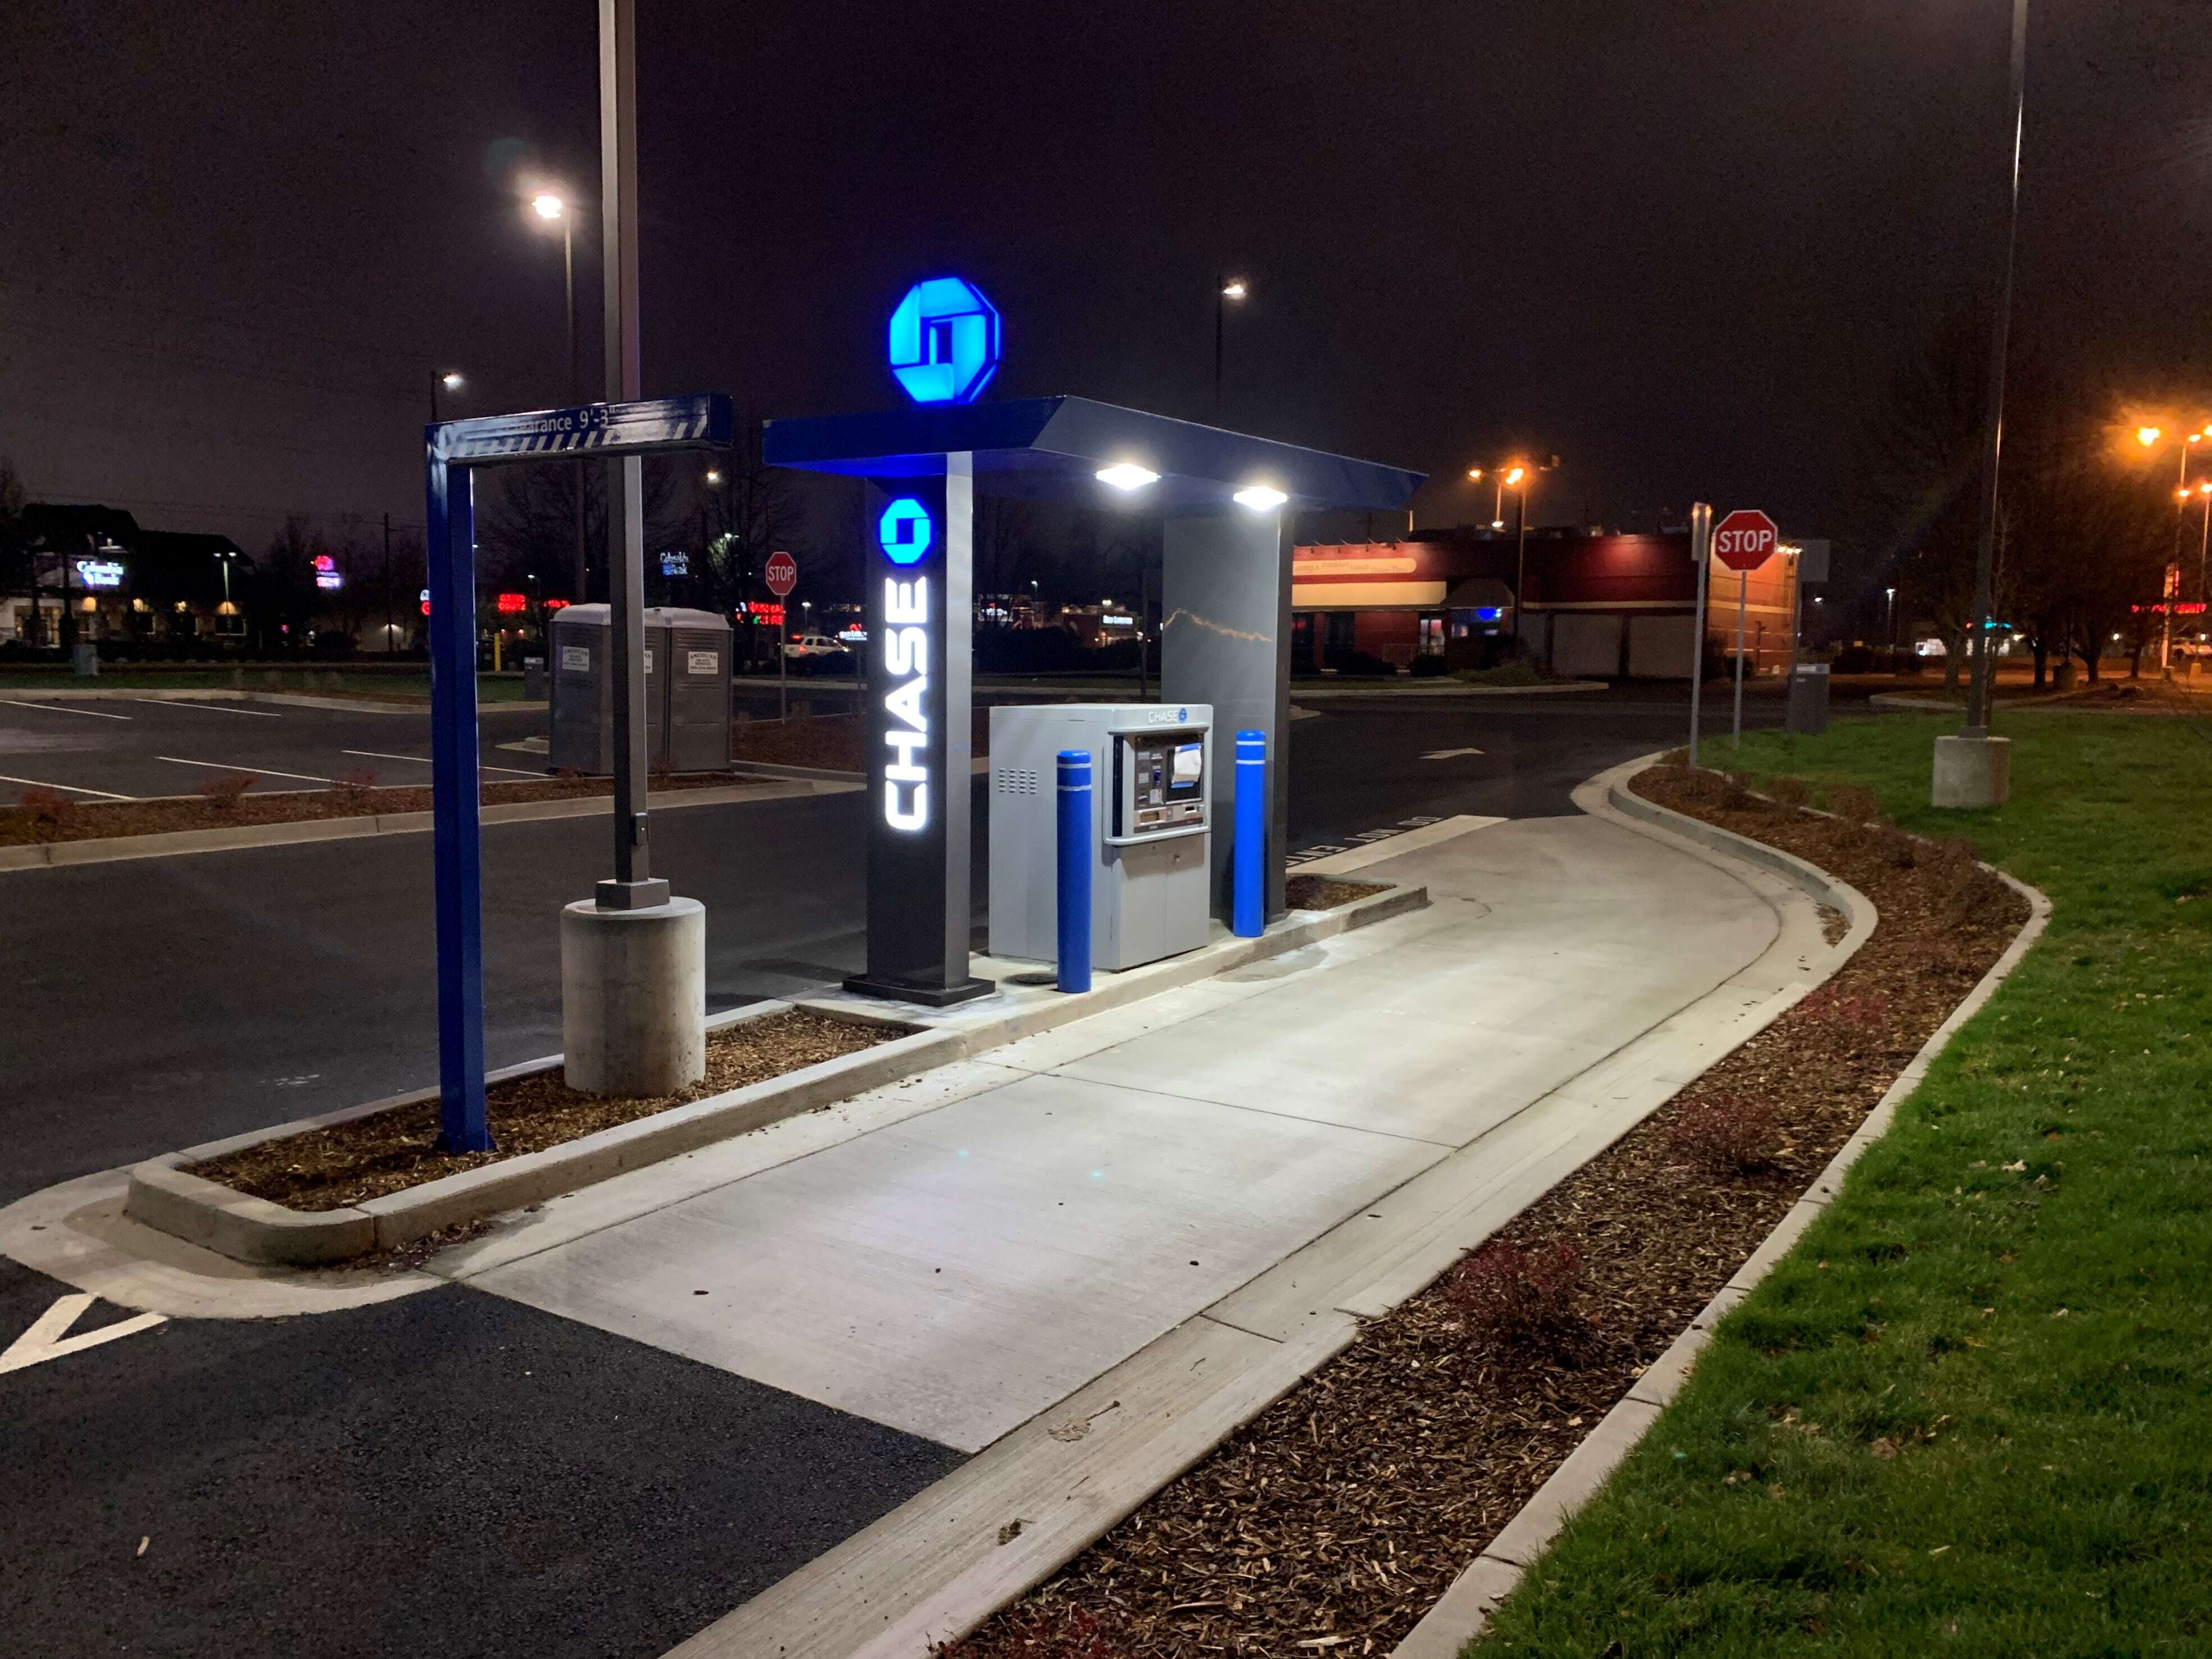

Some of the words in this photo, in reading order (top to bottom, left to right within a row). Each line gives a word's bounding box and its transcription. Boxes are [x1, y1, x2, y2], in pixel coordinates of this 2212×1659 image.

[1718, 529, 1772, 552] STOP
[768, 565, 794, 581] STOP
[885, 576, 927, 830] CHASE
[1149, 710, 1178, 723] CHASE
[1286, 845, 1348, 866] ENT
